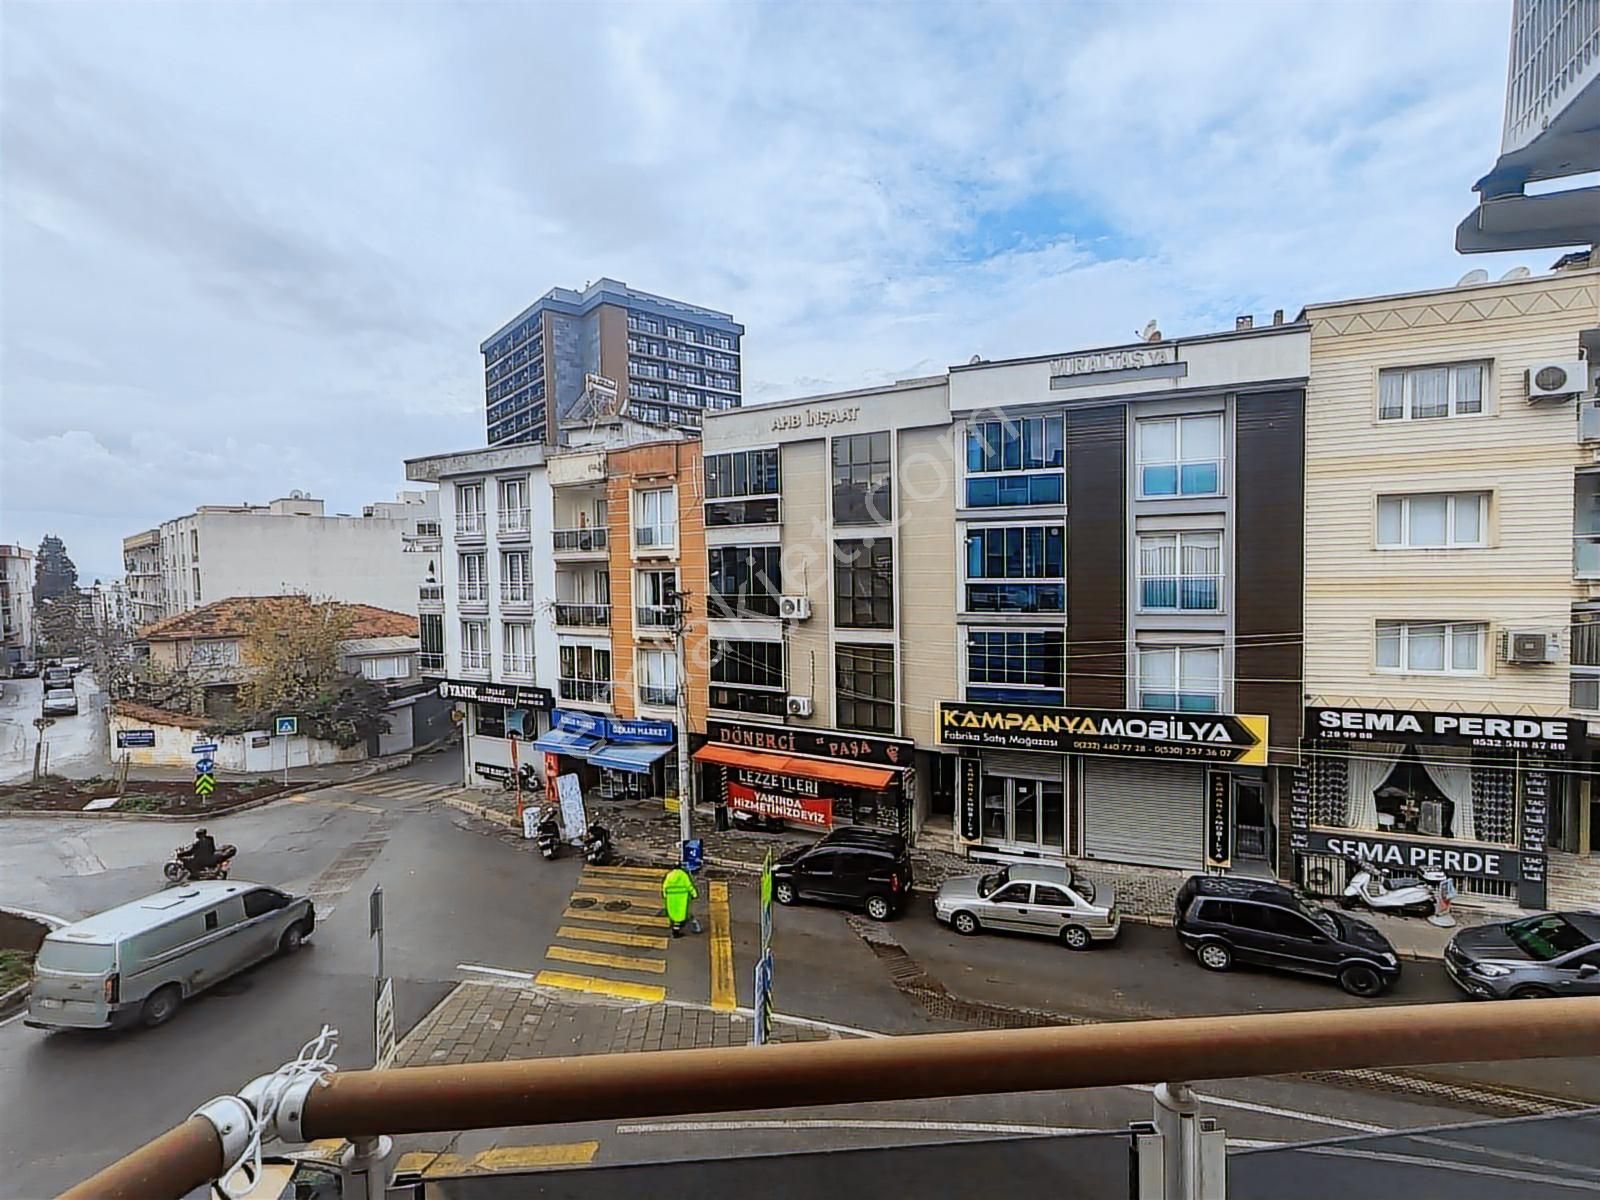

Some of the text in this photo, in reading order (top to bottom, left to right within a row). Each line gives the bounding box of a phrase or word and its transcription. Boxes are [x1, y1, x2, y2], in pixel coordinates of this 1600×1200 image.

[771, 407, 860, 432] AHB İNŞAAT
[1318, 710, 1568, 740] SEMA PERDE
[720, 726, 796, 751] DÖNERCİ
[944, 730, 1058, 748] Fabrika Satış Mağazası
[734, 797, 825, 823] HİZMETİNİZDEYİZ
[754, 791, 802, 808] YAKINDA
[1327, 839, 1403, 865] SEMA
[1410, 847, 1500, 875] PERDE
